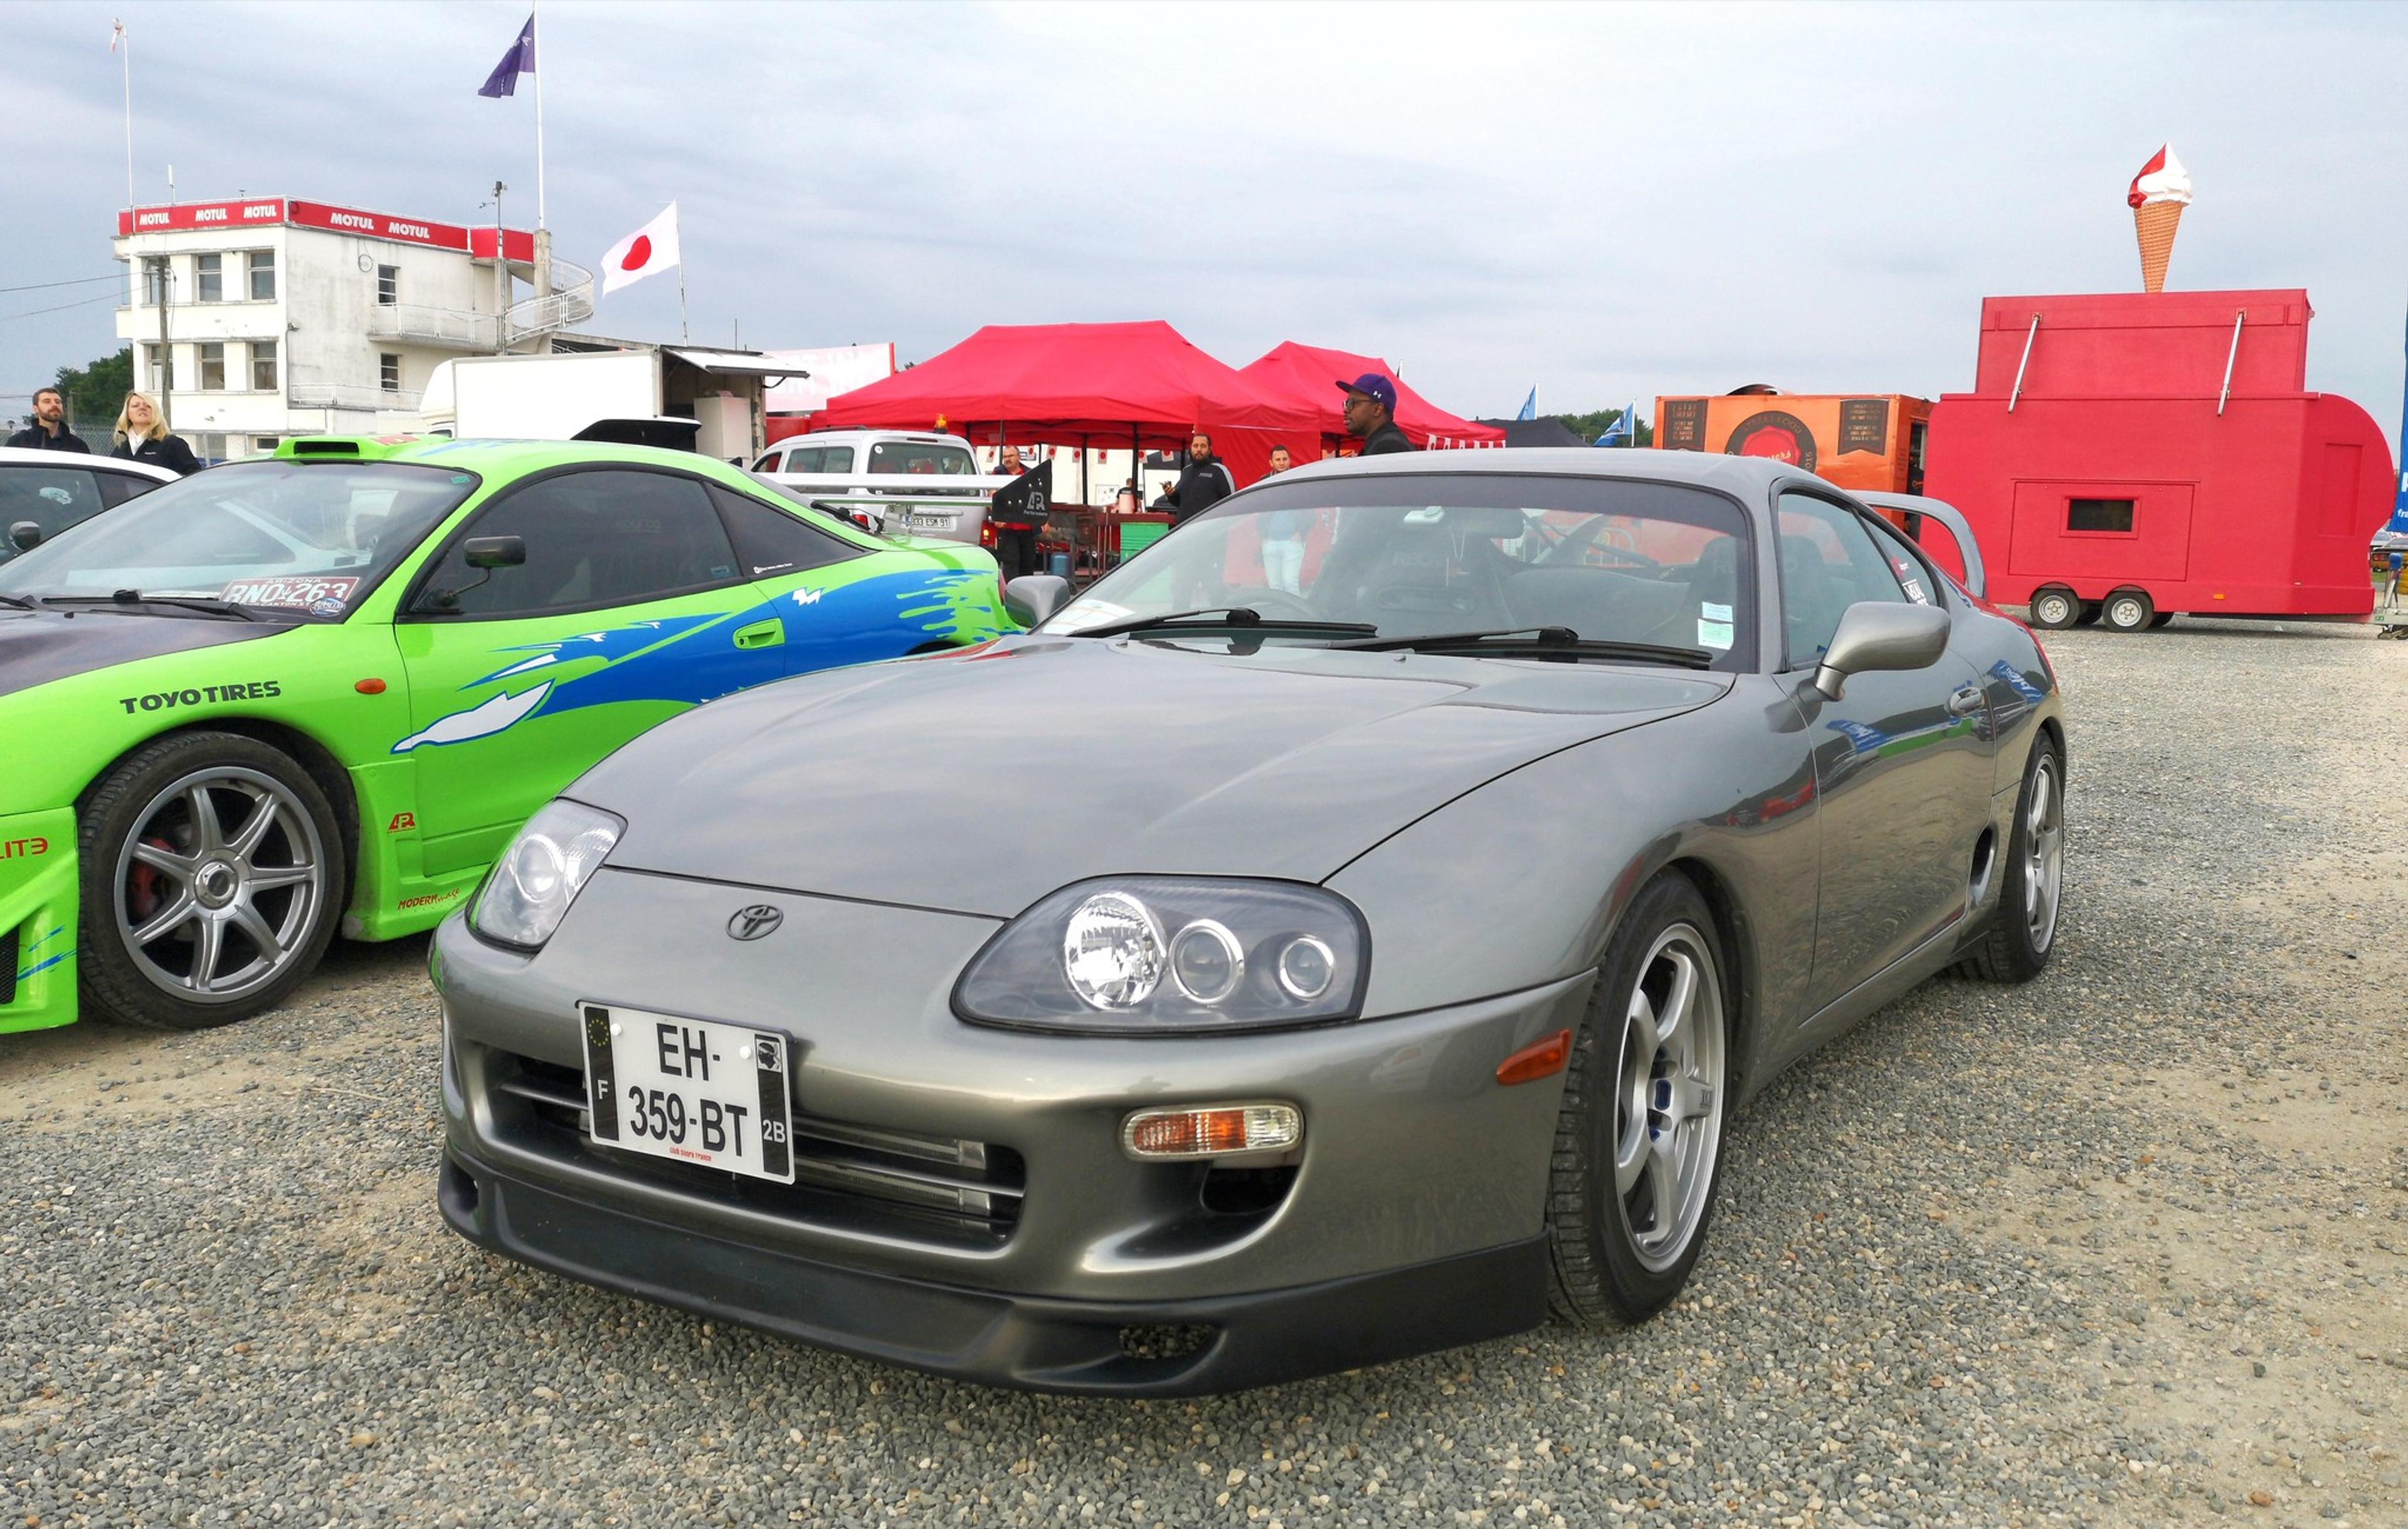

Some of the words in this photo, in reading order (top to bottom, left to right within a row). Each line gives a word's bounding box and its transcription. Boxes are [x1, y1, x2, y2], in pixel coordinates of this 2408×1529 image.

[139, 213, 169, 226] MOTUL
[195, 208, 228, 221] MOTUL
[243, 205, 277, 219] MOTUL
[330, 213, 374, 230] MOTUL
[388, 222, 430, 239] MOTUL
[120, 689, 201, 715] TOYO
[203, 680, 281, 703] TIRES
[597, 1079, 608, 1100] F
[628, 1085, 748, 1157] 359-BT
[762, 1119, 786, 1144] 2B
